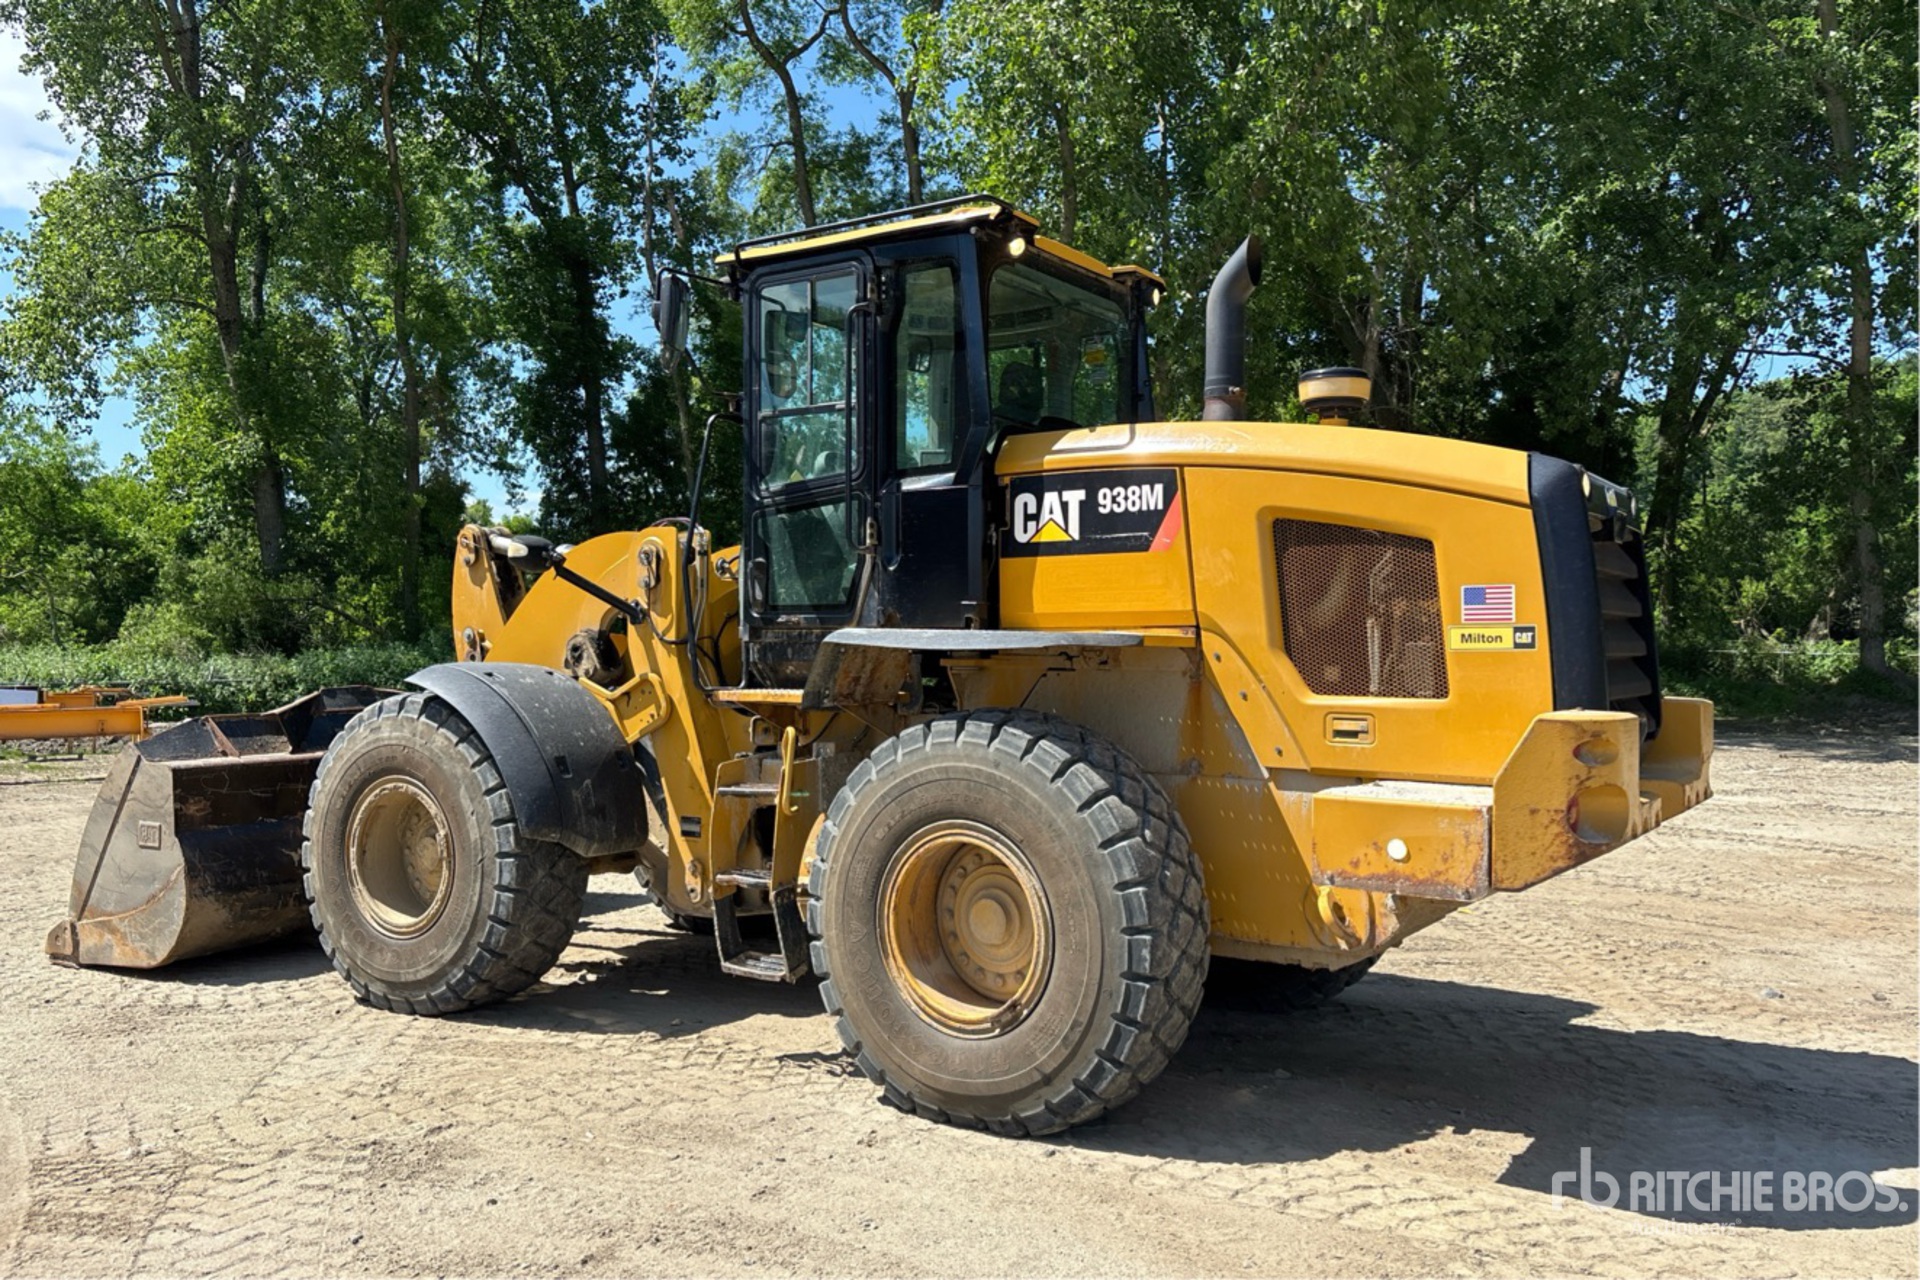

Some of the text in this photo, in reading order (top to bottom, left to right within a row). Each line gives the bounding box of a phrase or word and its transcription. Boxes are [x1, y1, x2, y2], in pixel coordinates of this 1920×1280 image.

[1014, 483, 1163, 543] CAT 938M
[1460, 633, 1503, 643] Milton
[1515, 632, 1534, 643] CAT
